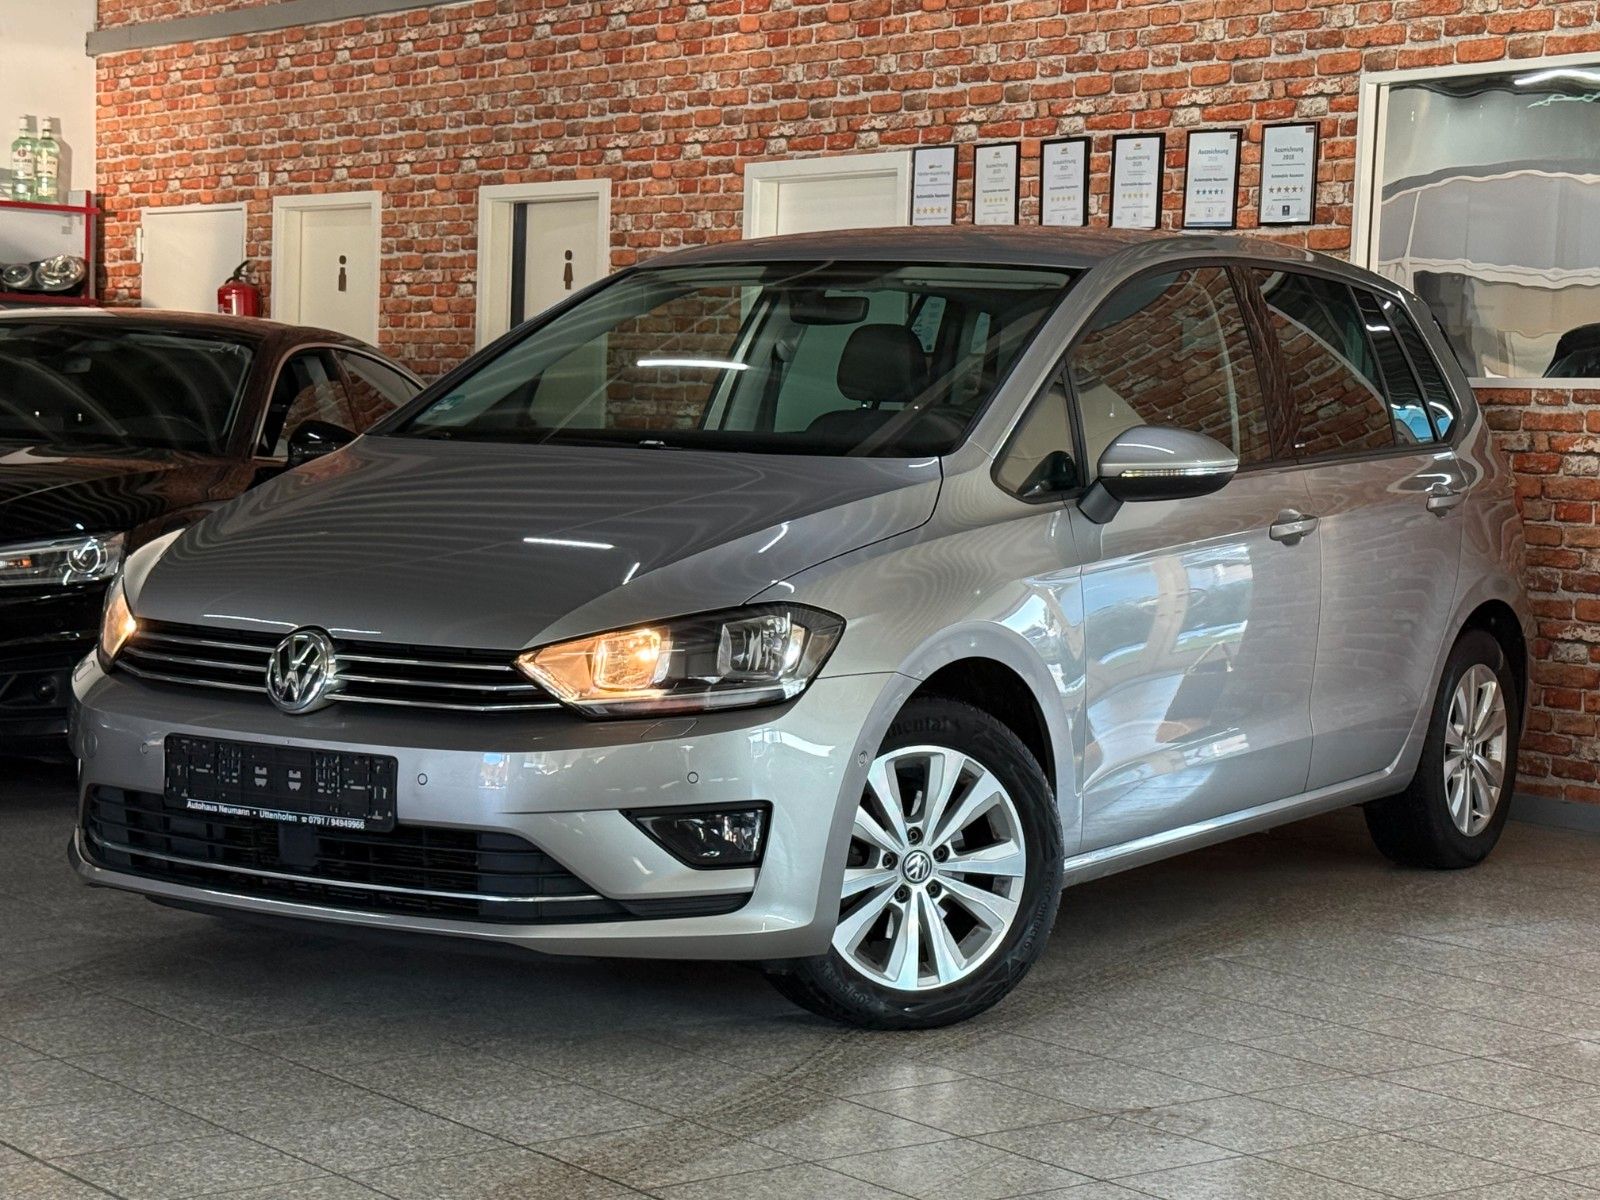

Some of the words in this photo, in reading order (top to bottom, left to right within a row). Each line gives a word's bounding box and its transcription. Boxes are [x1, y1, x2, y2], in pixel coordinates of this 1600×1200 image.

[186, 800, 218, 812] Autohaus
[218, 804, 251, 816] Neumann
[259, 810, 298, 823] Uttenhofen
[308, 815, 325, 826] 0791
